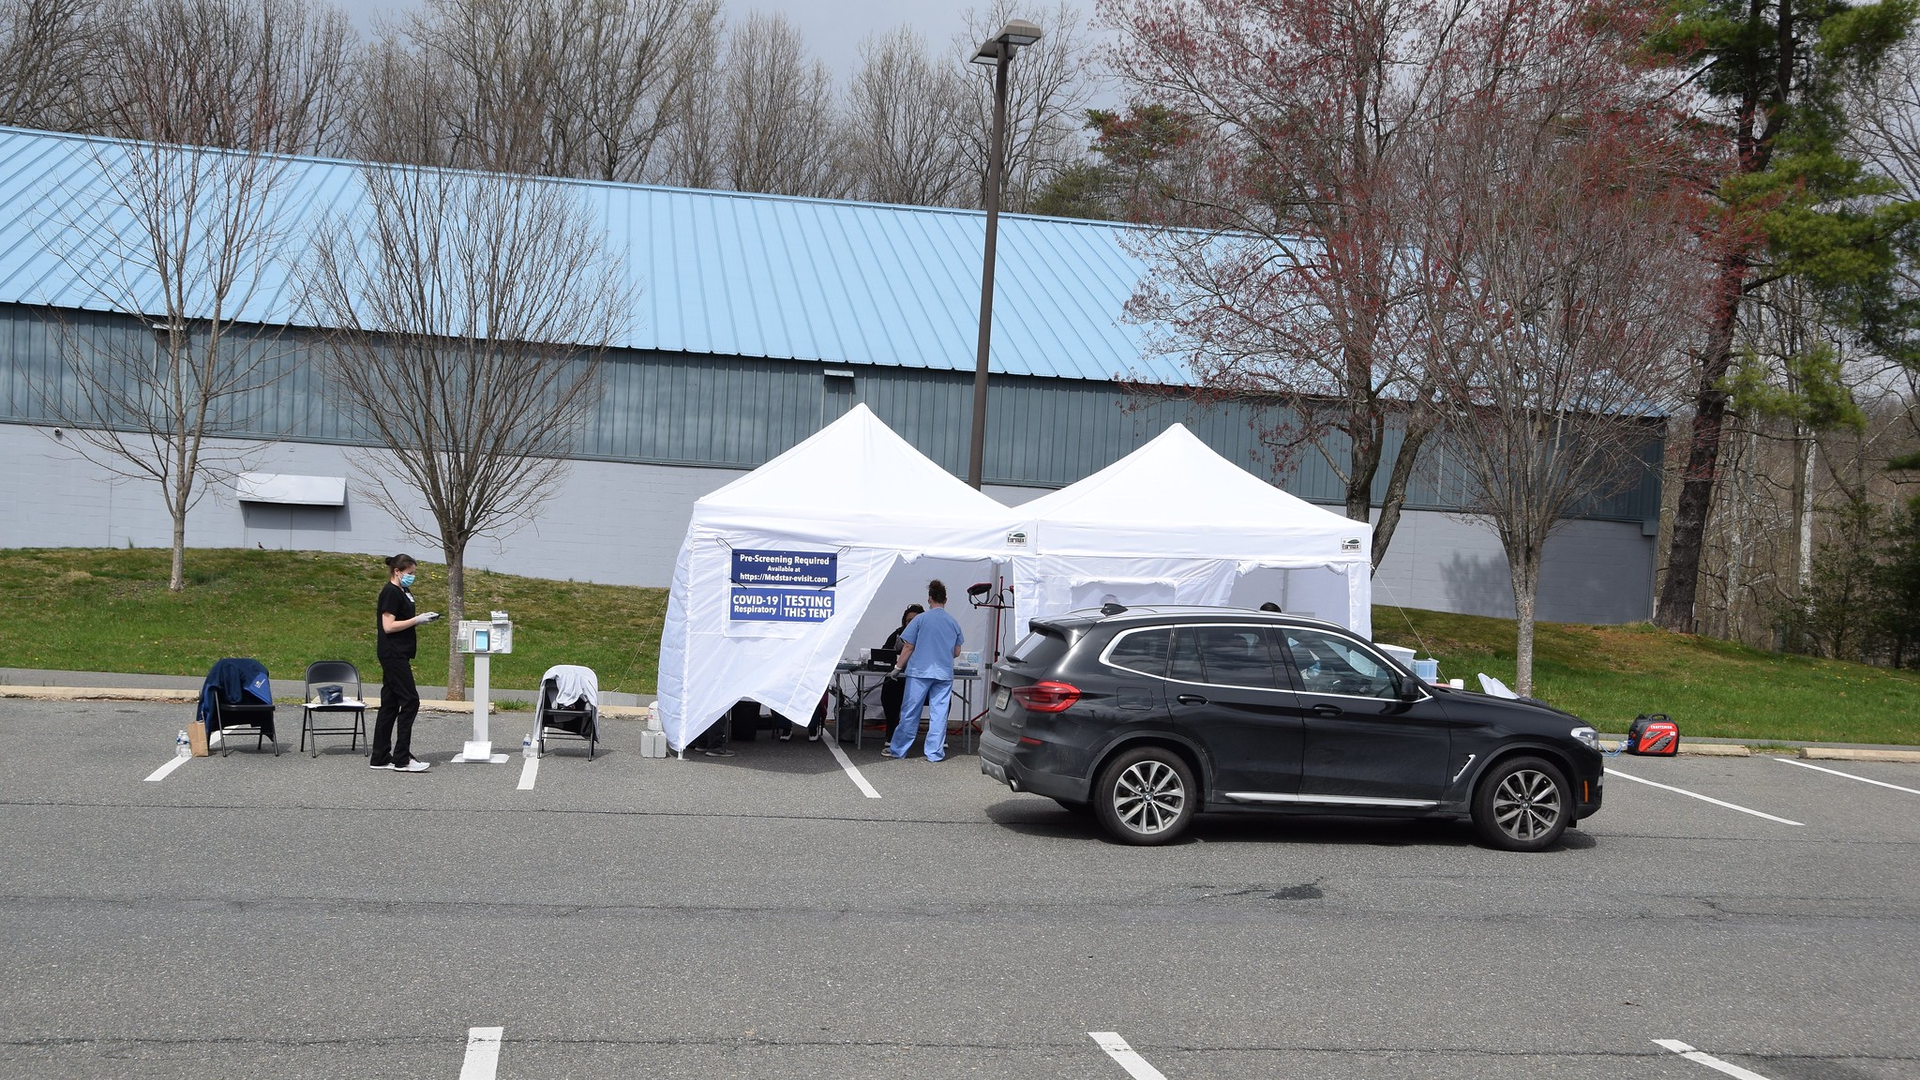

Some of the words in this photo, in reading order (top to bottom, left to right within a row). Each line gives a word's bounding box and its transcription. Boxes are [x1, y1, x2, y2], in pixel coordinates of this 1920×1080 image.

[740, 554, 792, 565] Pre-Screening
[794, 556, 830, 566] Required
[767, 565, 794, 573] Available
[740, 573, 828, 583] https://Medstar-evisit.com
[732, 595, 779, 605] COVID-19
[784, 595, 832, 608] TESTING
[734, 605, 777, 615] Respiratory
[784, 607, 809, 618] THIS
[808, 608, 832, 618] TENT
